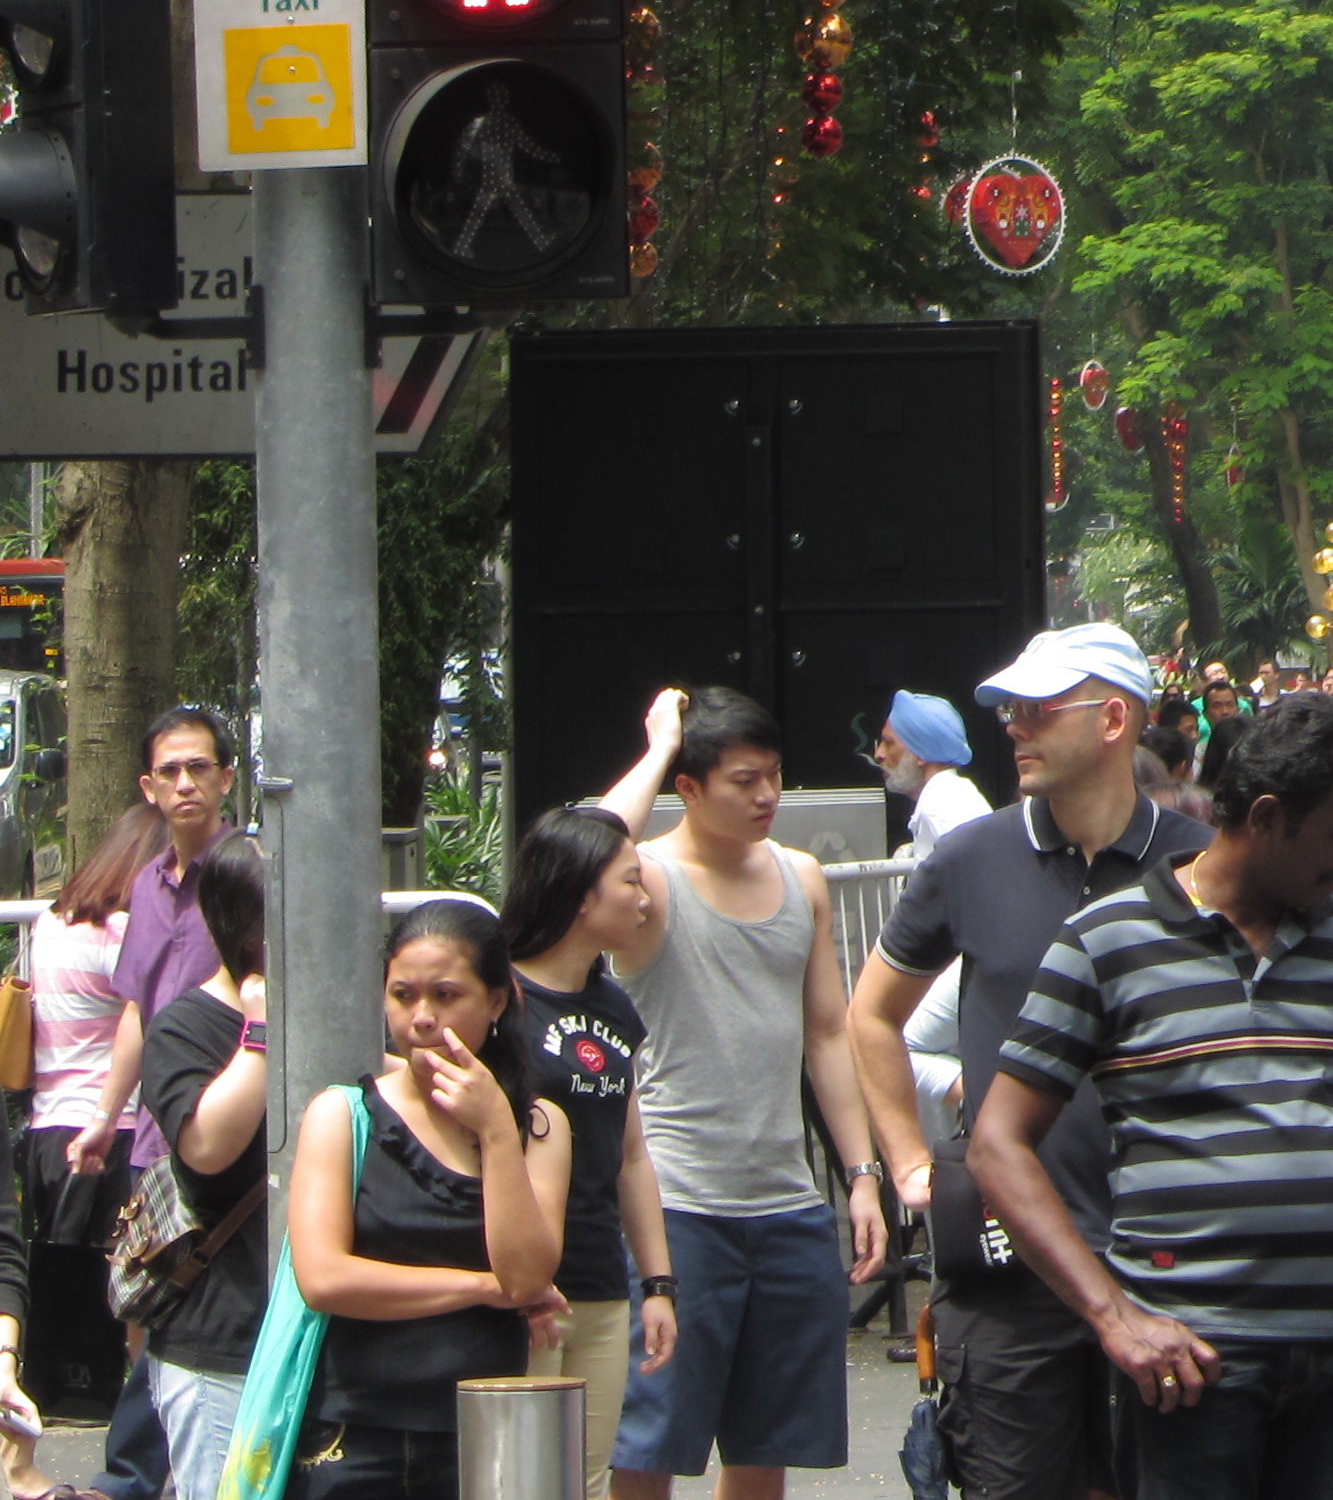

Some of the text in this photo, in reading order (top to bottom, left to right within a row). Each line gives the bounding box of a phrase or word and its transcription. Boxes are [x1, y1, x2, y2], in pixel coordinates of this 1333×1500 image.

[57, 349, 248, 402] Hospital
[571, 1073, 625, 1097] New York
